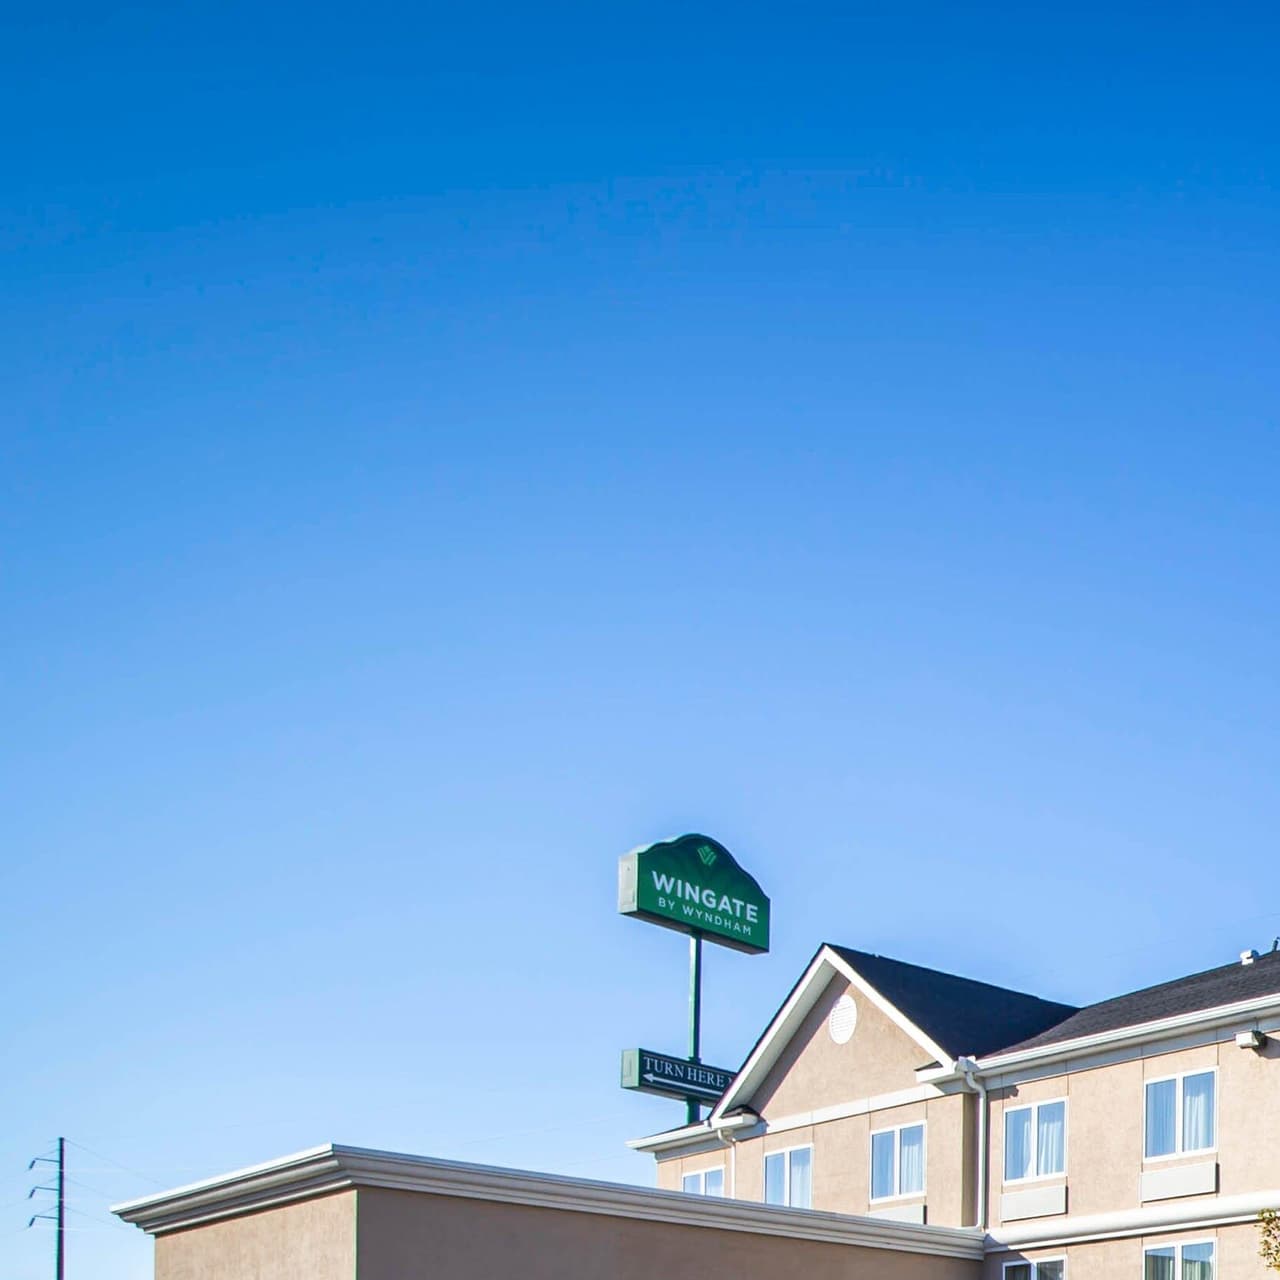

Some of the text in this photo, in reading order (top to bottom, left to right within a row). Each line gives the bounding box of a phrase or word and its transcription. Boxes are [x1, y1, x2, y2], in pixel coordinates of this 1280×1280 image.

[651, 870, 759, 923] WINGATE
[658, 897, 752, 936] BY WYNDHAM
[644, 1056, 684, 1078] TURN
[687, 1067, 725, 1088] HERE
